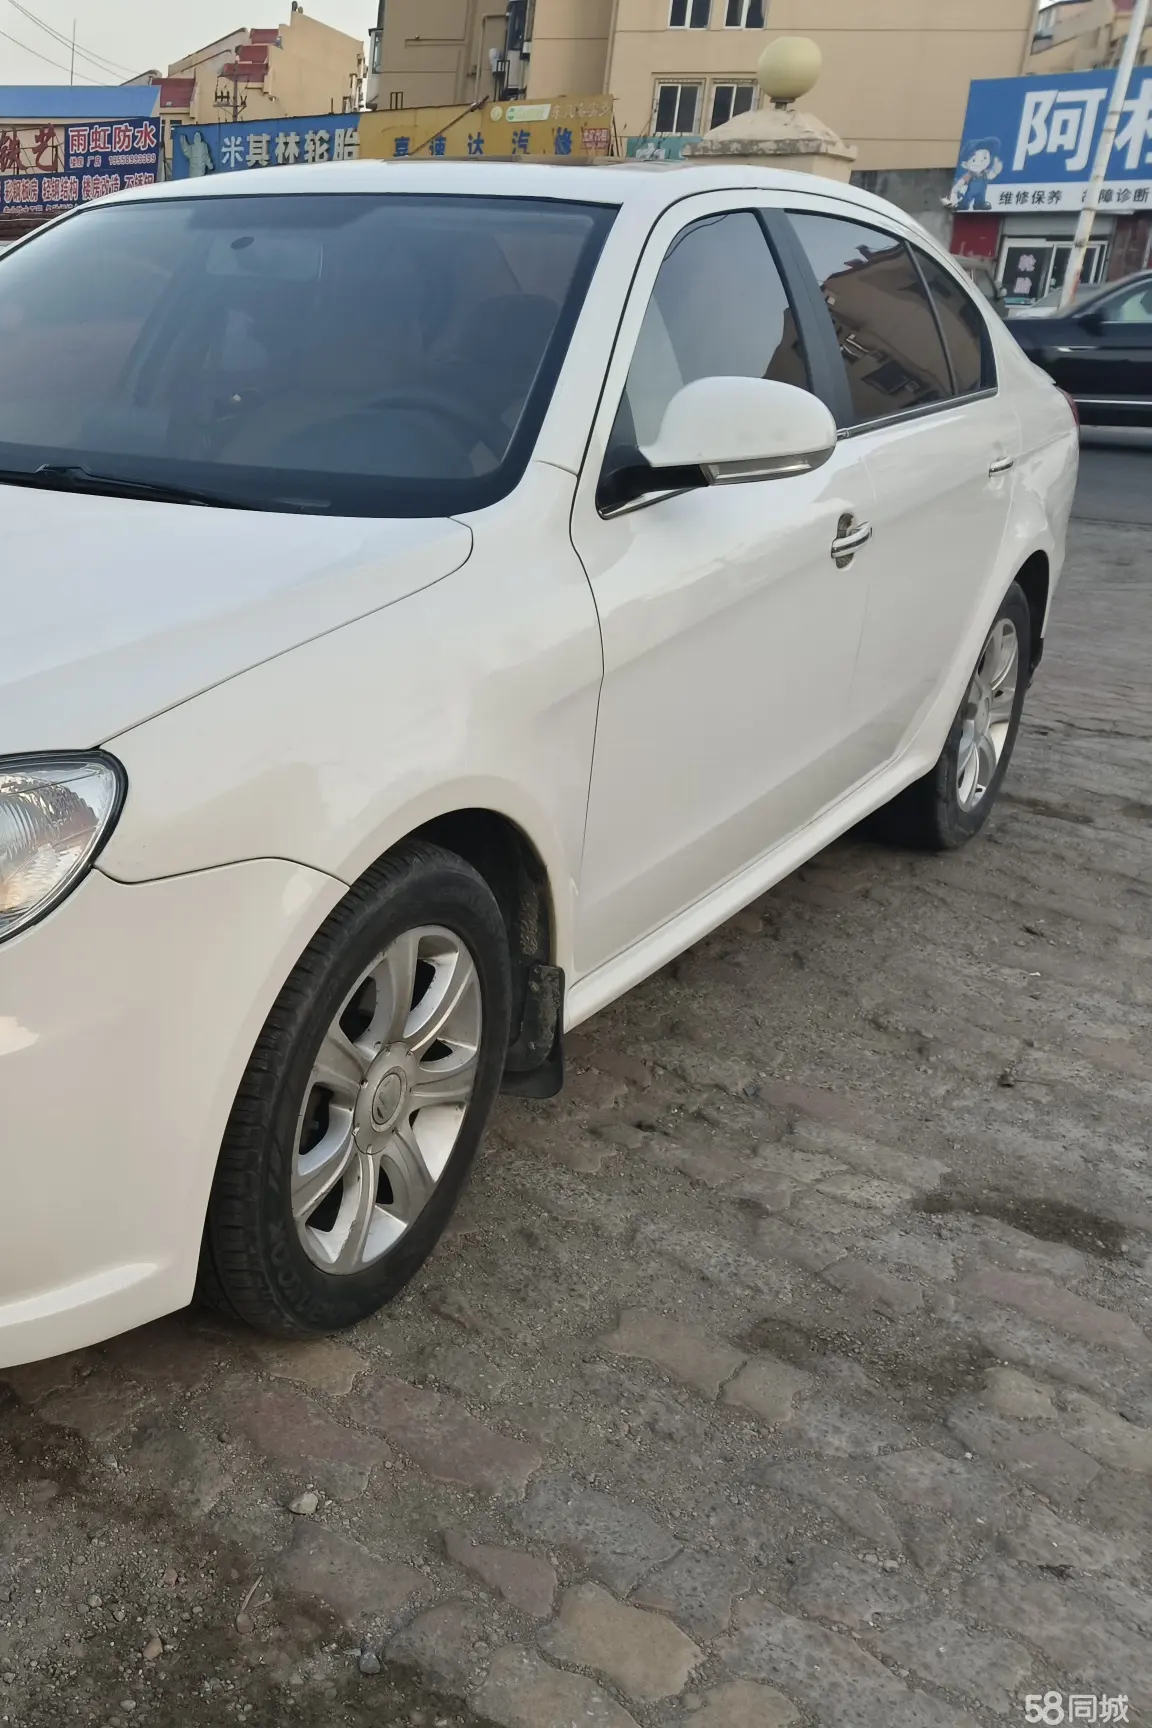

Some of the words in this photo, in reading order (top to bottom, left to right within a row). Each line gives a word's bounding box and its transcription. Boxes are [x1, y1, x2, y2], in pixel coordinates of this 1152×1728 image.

[68, 121, 156, 153] 雨虹防水
[221, 127, 360, 167] 米其林轮胎
[998, 190, 1062, 205] 维修保养
[1082, 187, 1151, 204] 障诊断
